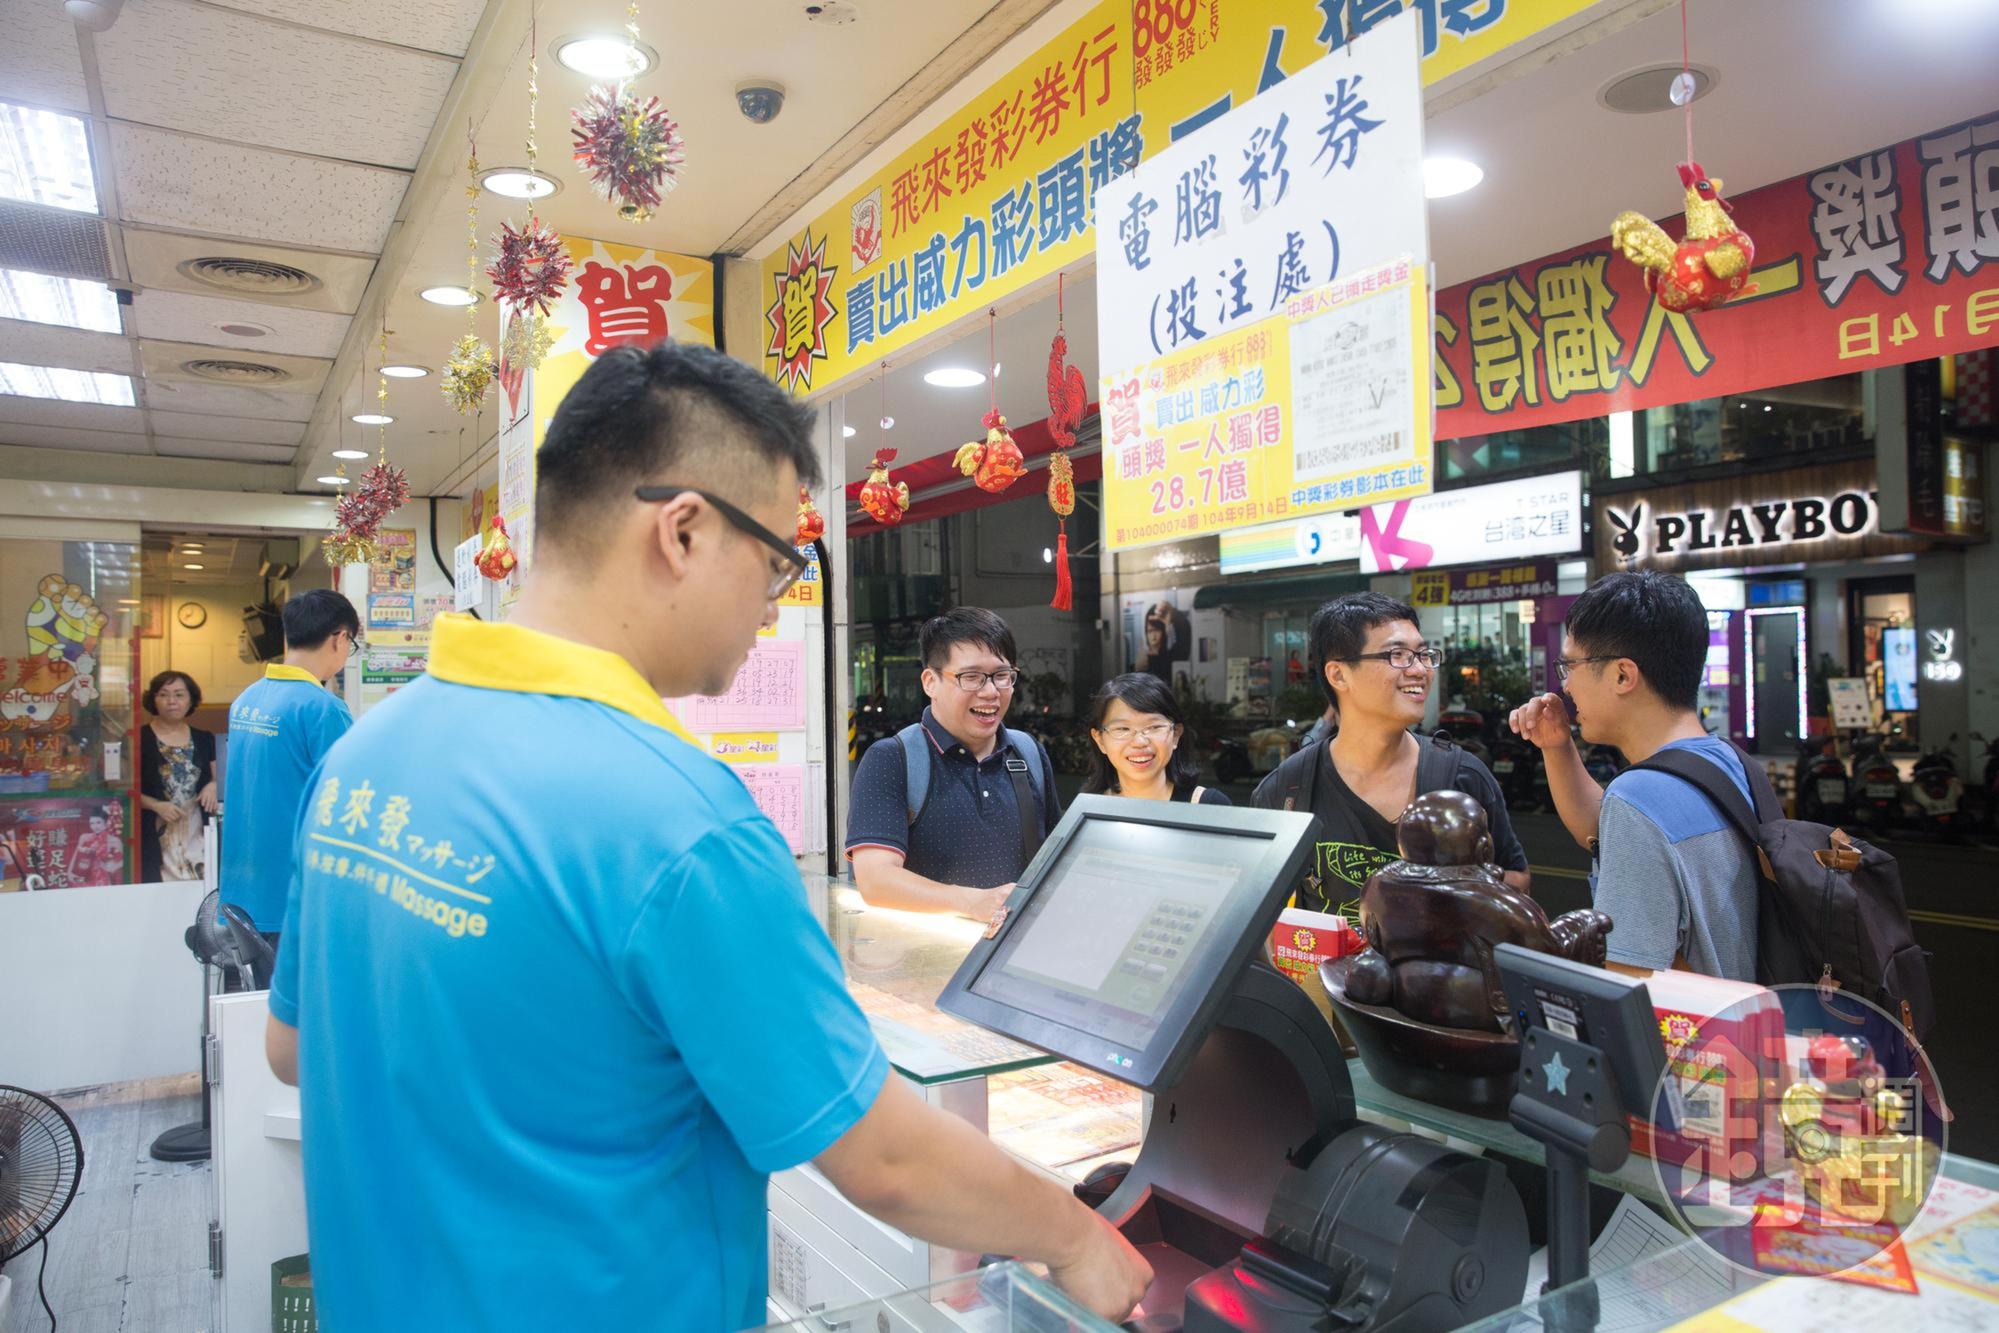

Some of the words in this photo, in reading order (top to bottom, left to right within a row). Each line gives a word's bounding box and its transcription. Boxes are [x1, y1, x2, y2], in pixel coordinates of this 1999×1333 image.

[1135, 27, 1196, 90] 發發發
[890, 23, 1120, 239] 飛來發彩券行
[1119, 74, 1387, 269] 電腦彩券
[783, 261, 818, 362] 賀
[1151, 459, 1247, 514] 28.7億
[1292, 464, 1425, 506] 中獎彩券影本在此
[1656, 491, 1879, 553] PLAYBO
